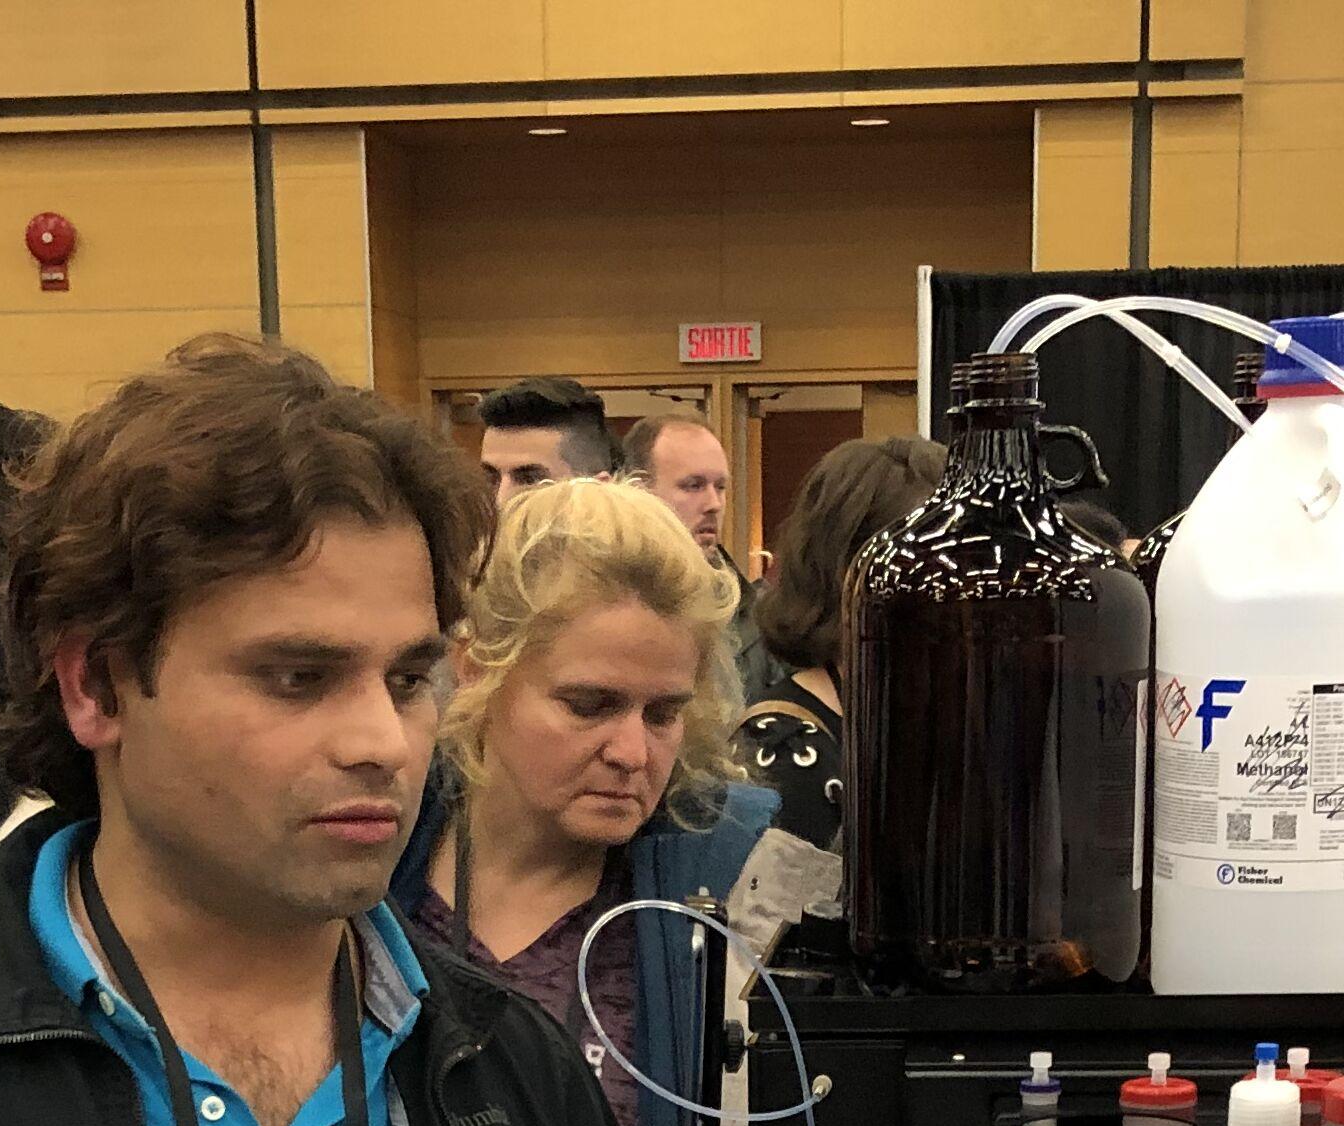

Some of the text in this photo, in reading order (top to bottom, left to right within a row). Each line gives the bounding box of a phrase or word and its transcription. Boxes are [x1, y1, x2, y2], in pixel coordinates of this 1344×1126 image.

[687, 326, 754, 359] SORTIE
[1236, 761, 1309, 777] Methanol
[1238, 866, 1269, 876] Fisher
[1238, 875, 1283, 885] Chemical
